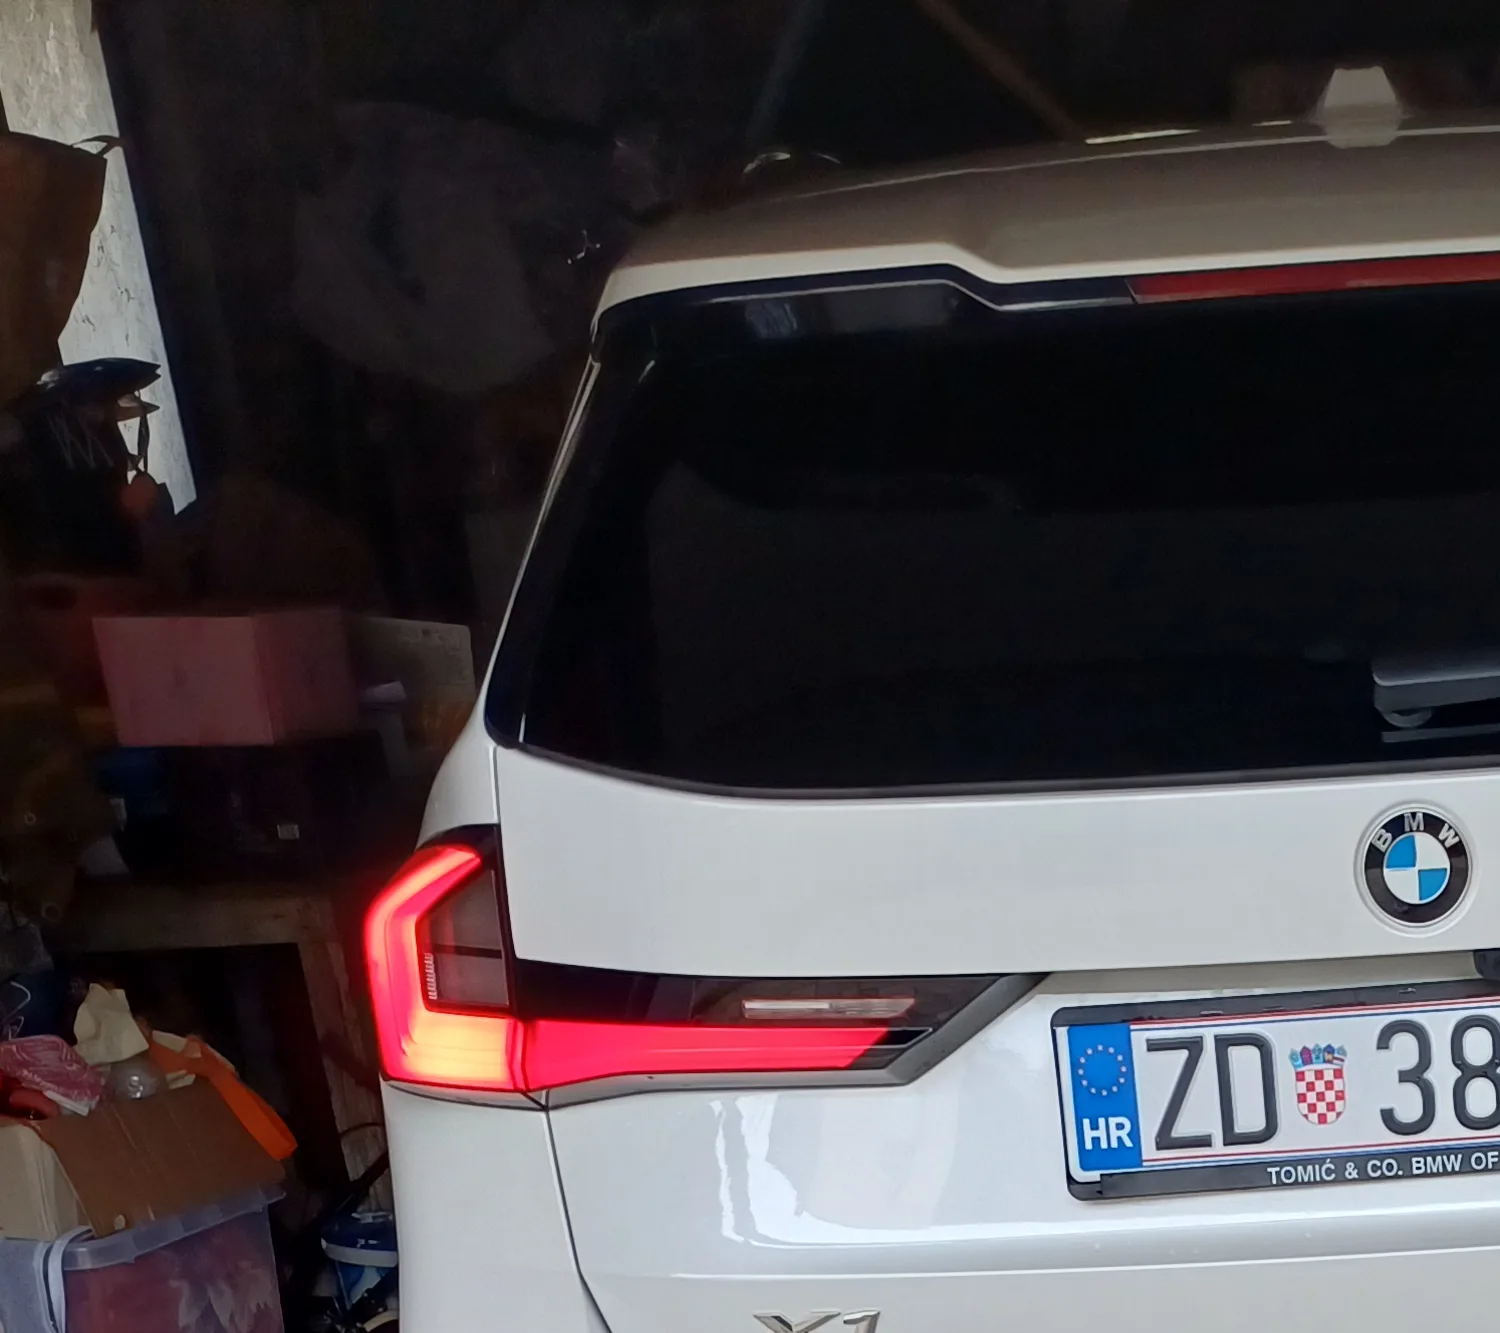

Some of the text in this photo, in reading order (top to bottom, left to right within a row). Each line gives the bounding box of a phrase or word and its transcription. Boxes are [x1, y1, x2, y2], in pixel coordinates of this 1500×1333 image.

[1371, 812, 1460, 852] BMW
[1145, 1033, 1280, 1151] ZD
[1082, 1117, 1133, 1150] HR
[1267, 1159, 1336, 1184] TOMIĆ
[1345, 1162, 1359, 1180] &
[1367, 1160, 1404, 1178] CO.
[1412, 1154, 1463, 1175] BMW
[1470, 1151, 1500, 1170] OF
